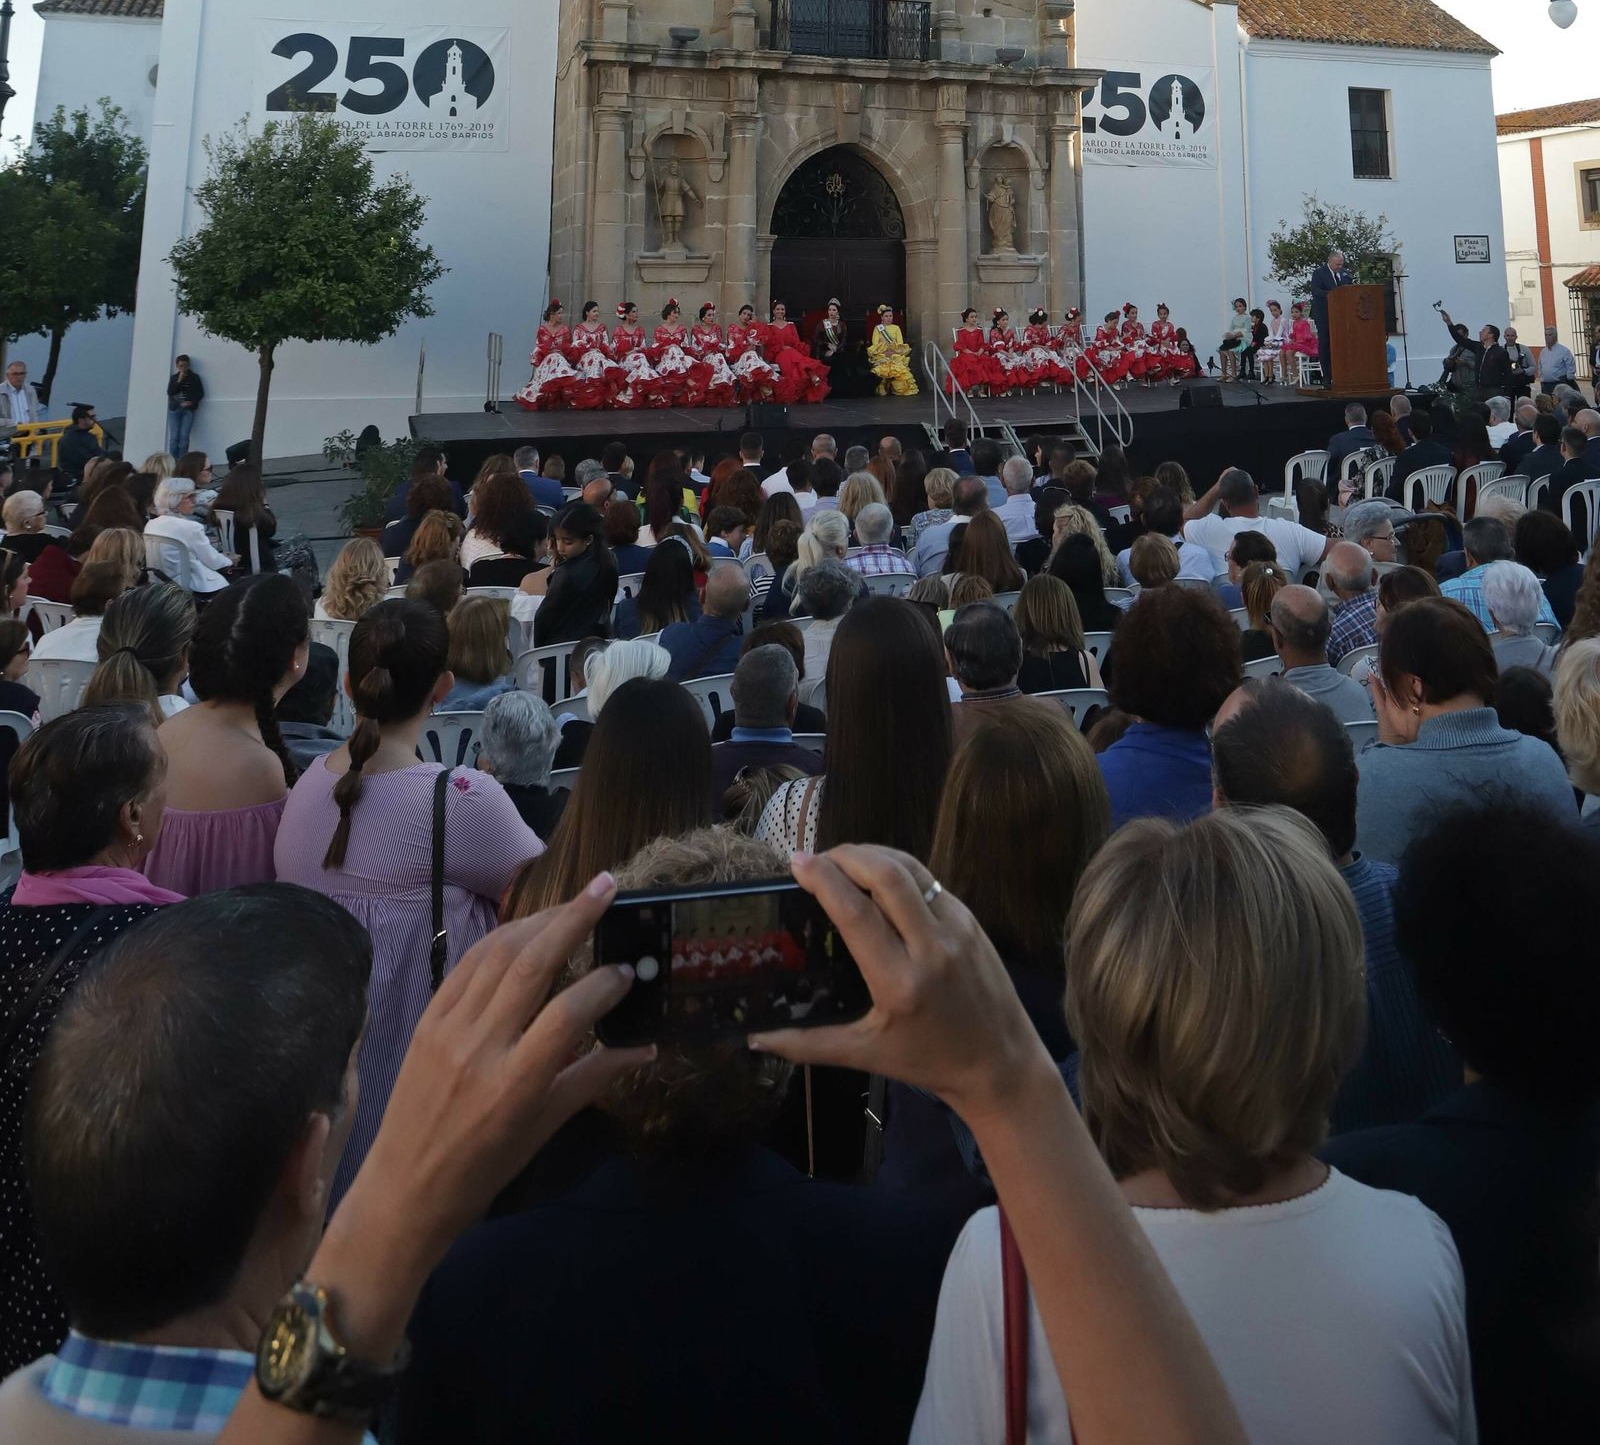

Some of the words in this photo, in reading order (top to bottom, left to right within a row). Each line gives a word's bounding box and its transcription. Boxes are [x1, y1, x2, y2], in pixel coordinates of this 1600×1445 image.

[266, 32, 495, 116] 250
[356, 120, 371, 129] DE
[377, 121, 390, 130] LA
[394, 121, 434, 131] TORRE
[439, 122, 494, 132] 1769-2019
[369, 130, 426, 138] LABRADOR
[429, 131, 448, 139] LOS
[452, 131, 494, 139] BARRIOS
[1110, 140, 1122, 148] DE
[1125, 141, 1136, 149] LA
[1138, 142, 1166, 150] TORRE
[1169, 143, 1207, 152] 1769-2019
